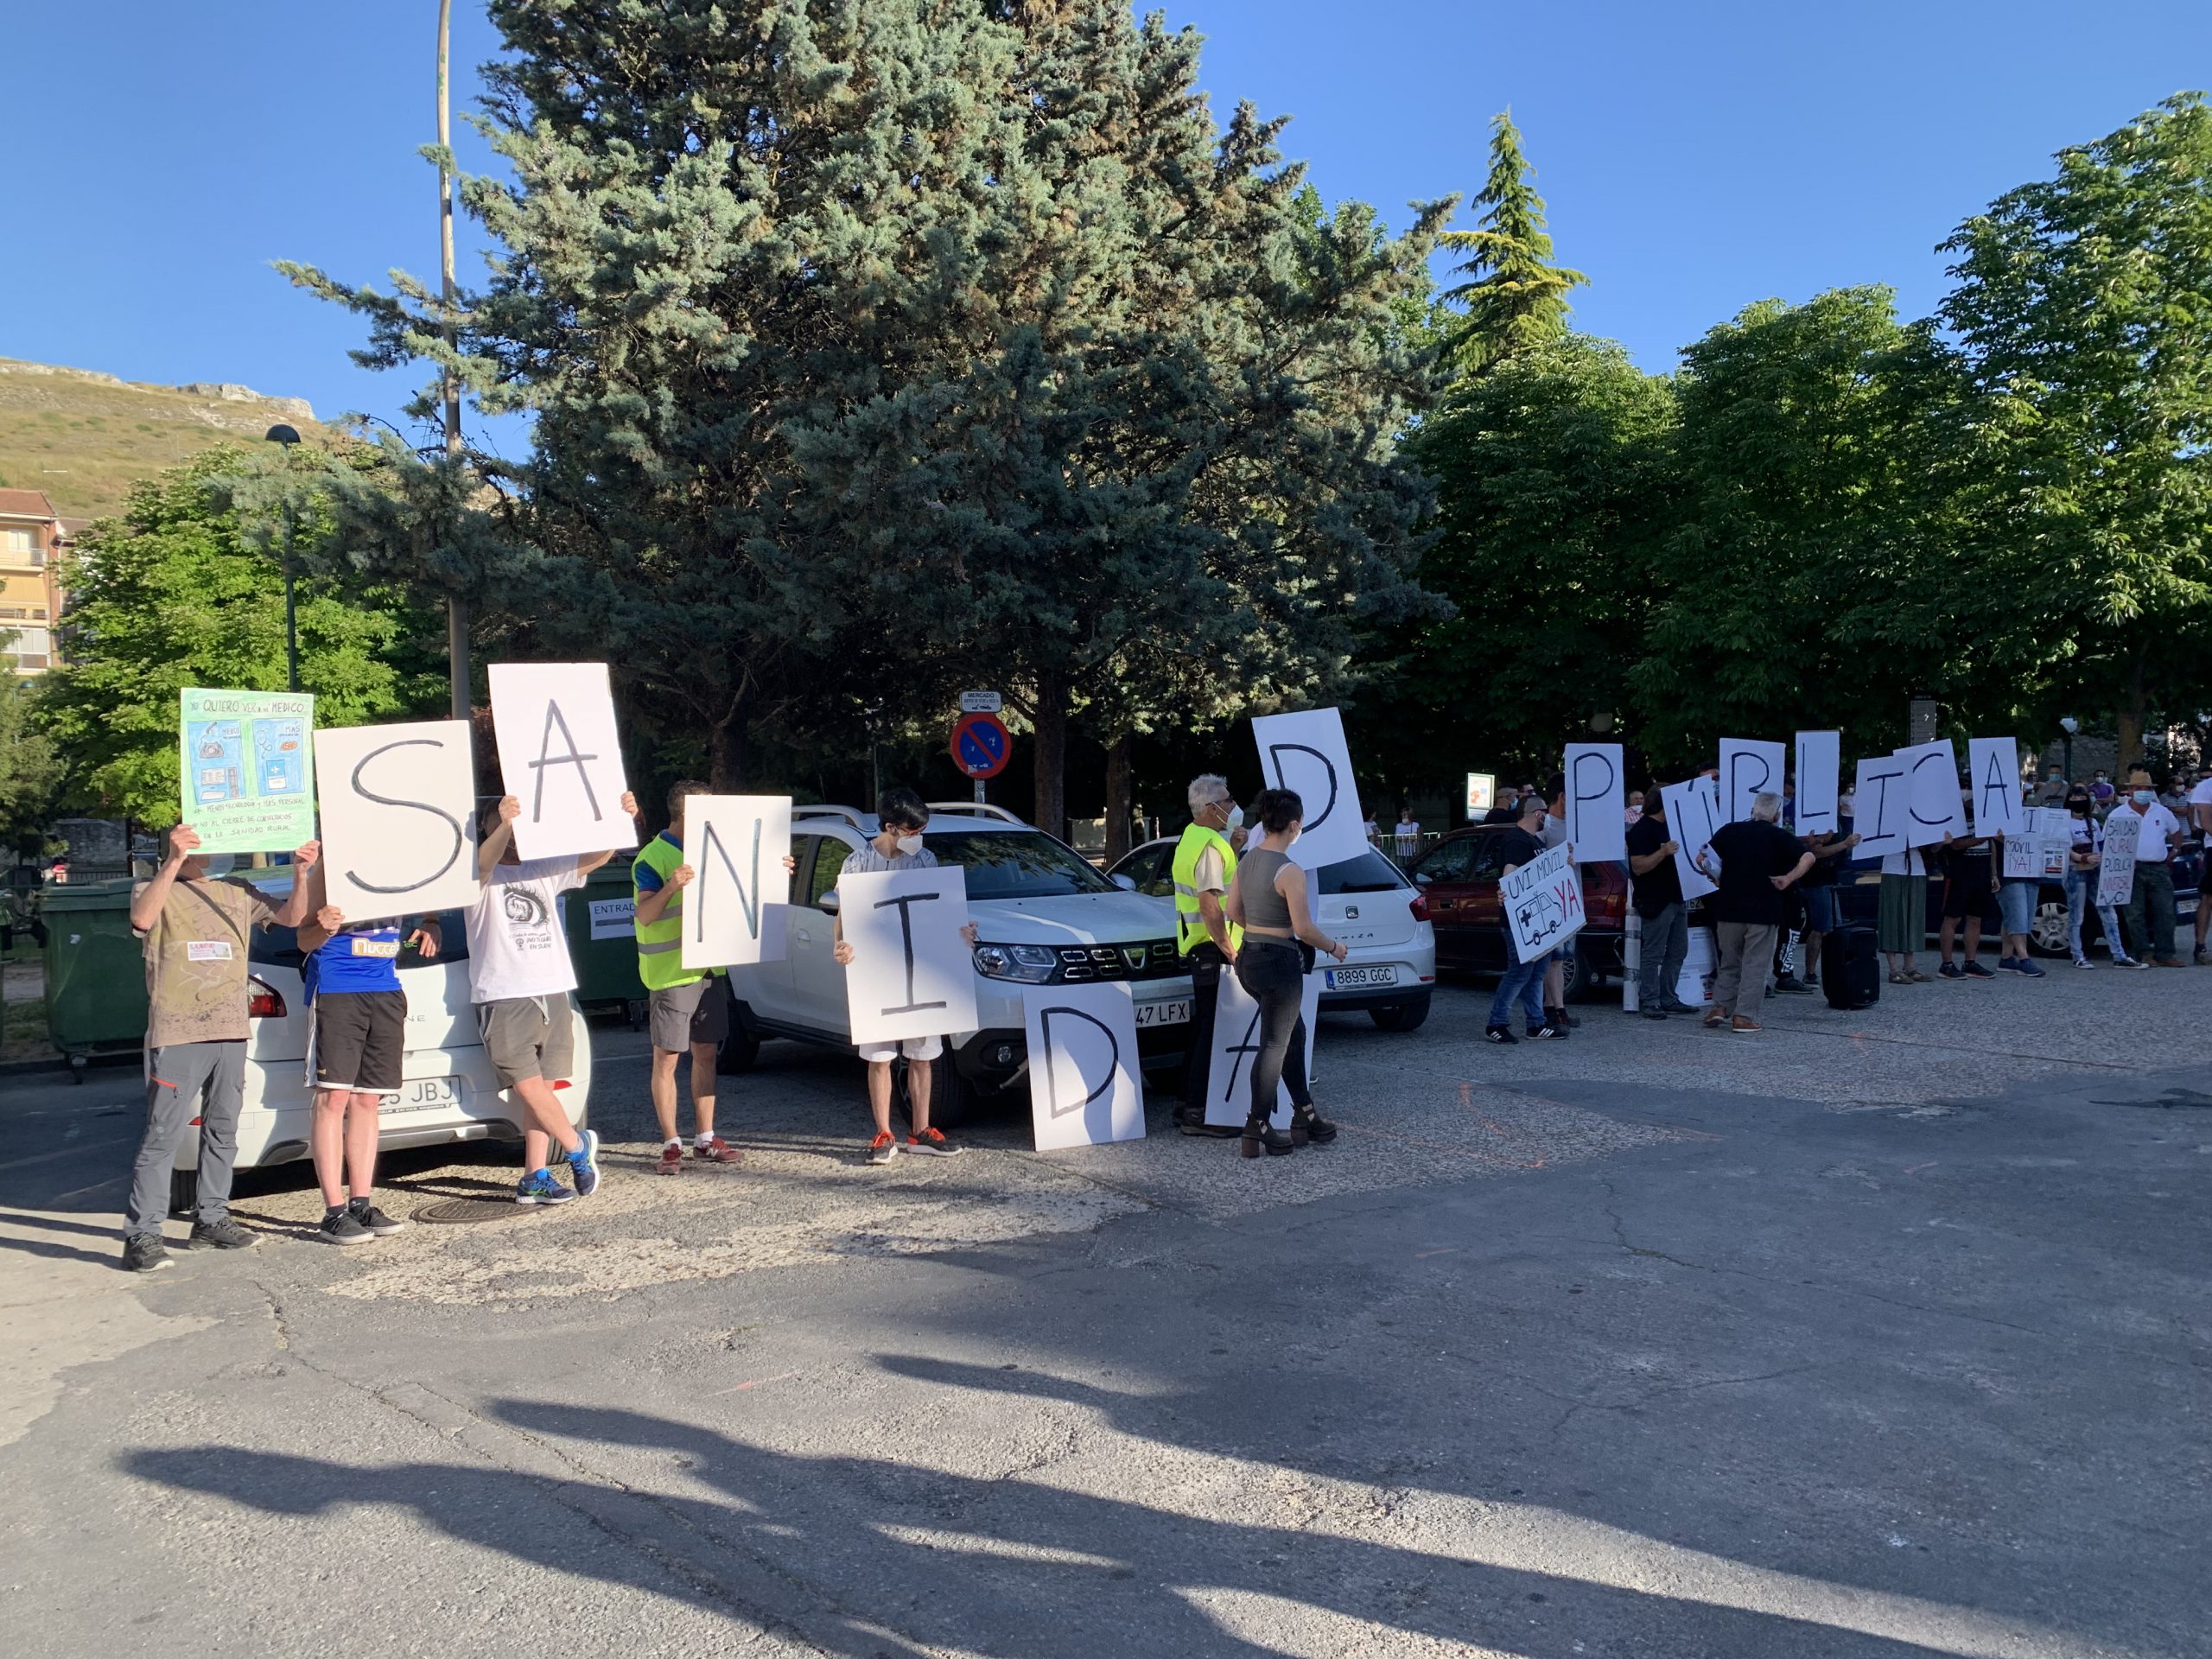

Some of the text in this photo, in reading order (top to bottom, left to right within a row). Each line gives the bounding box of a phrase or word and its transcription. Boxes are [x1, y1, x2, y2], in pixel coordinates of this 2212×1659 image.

[203, 699, 239, 712] QUIERO
[243, 702, 256, 712] VER
[528, 698, 603, 823] A
[1269, 744, 1338, 834] D
[1801, 743, 1830, 818] L
[1909, 752, 1954, 825] C
[1982, 751, 2011, 820] A
[346, 740, 462, 894] S
[1573, 752, 1614, 843] P
[1862, 772, 1904, 842] I
[696, 818, 762, 943] N
[1508, 867, 1535, 899] UVI
[1554, 878, 1580, 922] YA
[873, 892, 948, 1017] I
[1337, 968, 1392, 984] 8899 GGC
[1135, 1002, 1186, 1024] 47 LFX
[411, 1080, 453, 1103] JBJ
[1040, 1006, 1119, 1120] D
